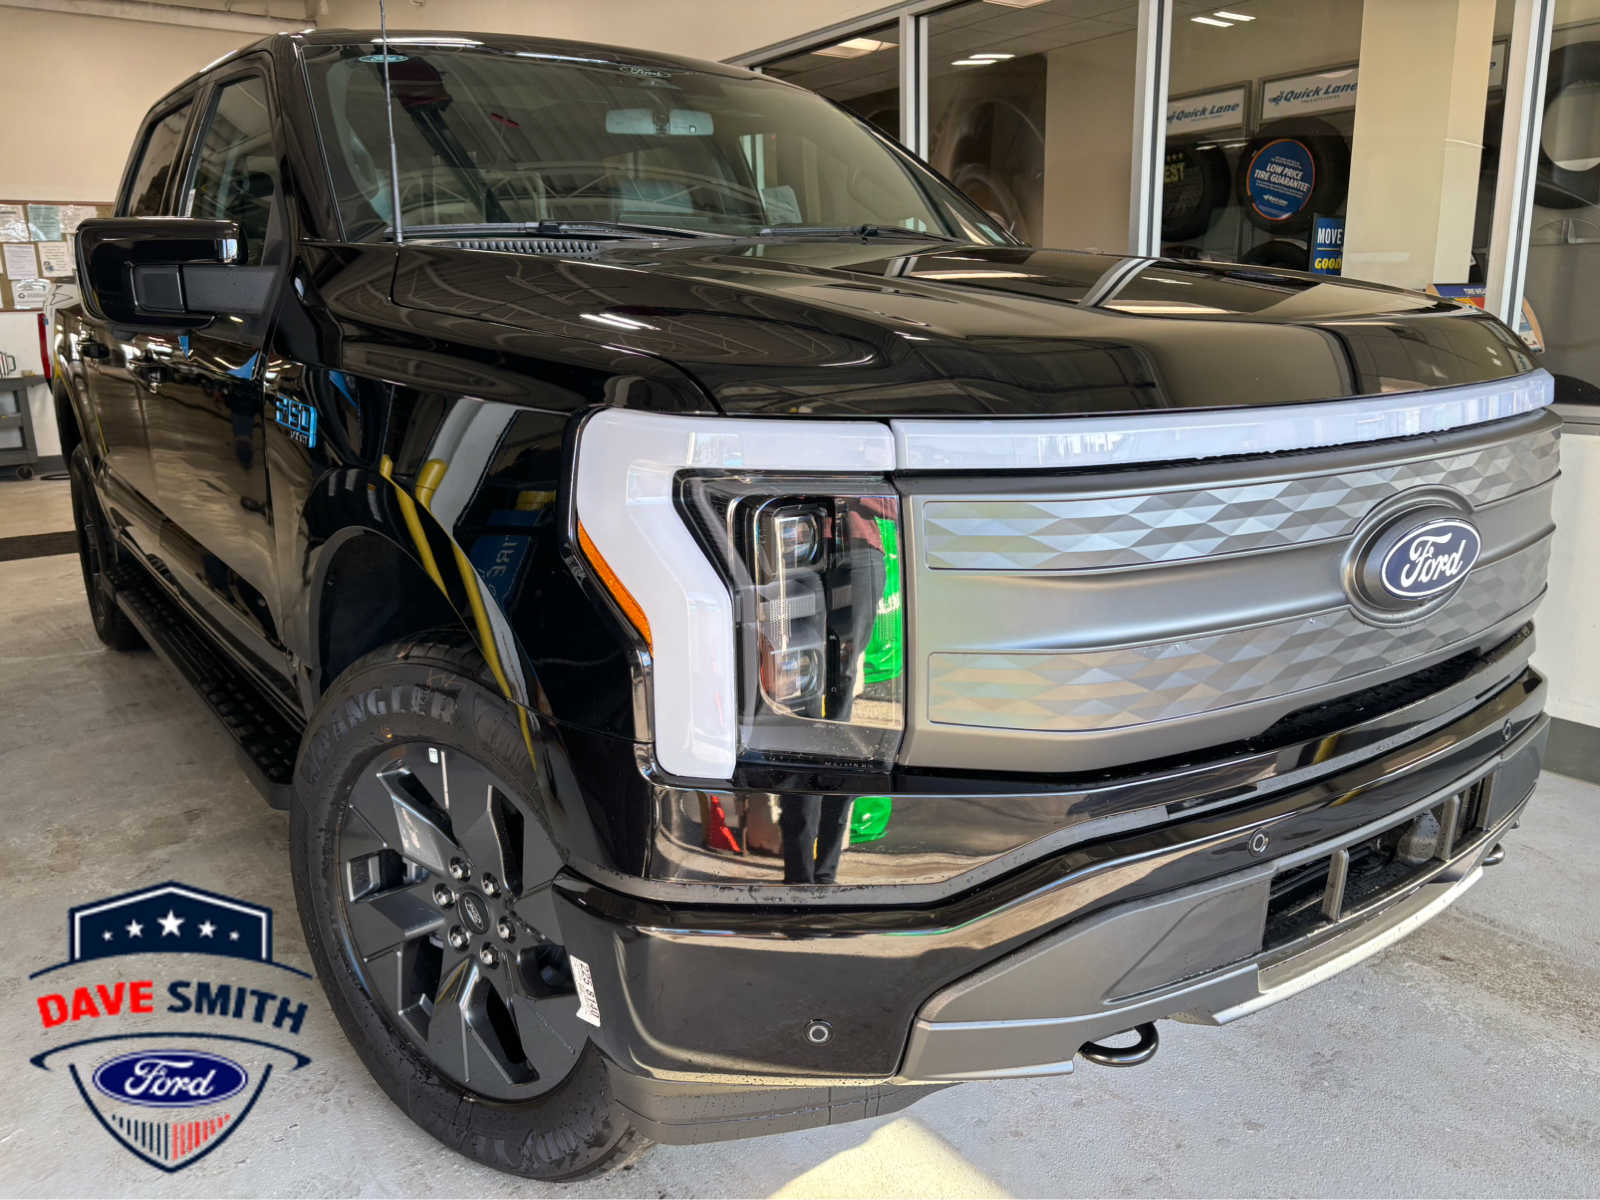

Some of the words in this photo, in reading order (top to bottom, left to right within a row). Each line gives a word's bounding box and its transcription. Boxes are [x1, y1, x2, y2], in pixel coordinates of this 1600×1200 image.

[1284, 86, 1322, 102] Quick
[1323, 82, 1358, 95] Lane
[1176, 107, 1207, 121] Quick
[1208, 103, 1240, 115] Lane
[1254, 168, 1271, 181] TIRE
[1270, 173, 1309, 192] GUARANTEE
[1266, 162, 1284, 175] LOW
[1283, 166, 1304, 180] PRICE
[1317, 228, 1343, 244] MOVE
[1400, 532, 1466, 588] Ford
